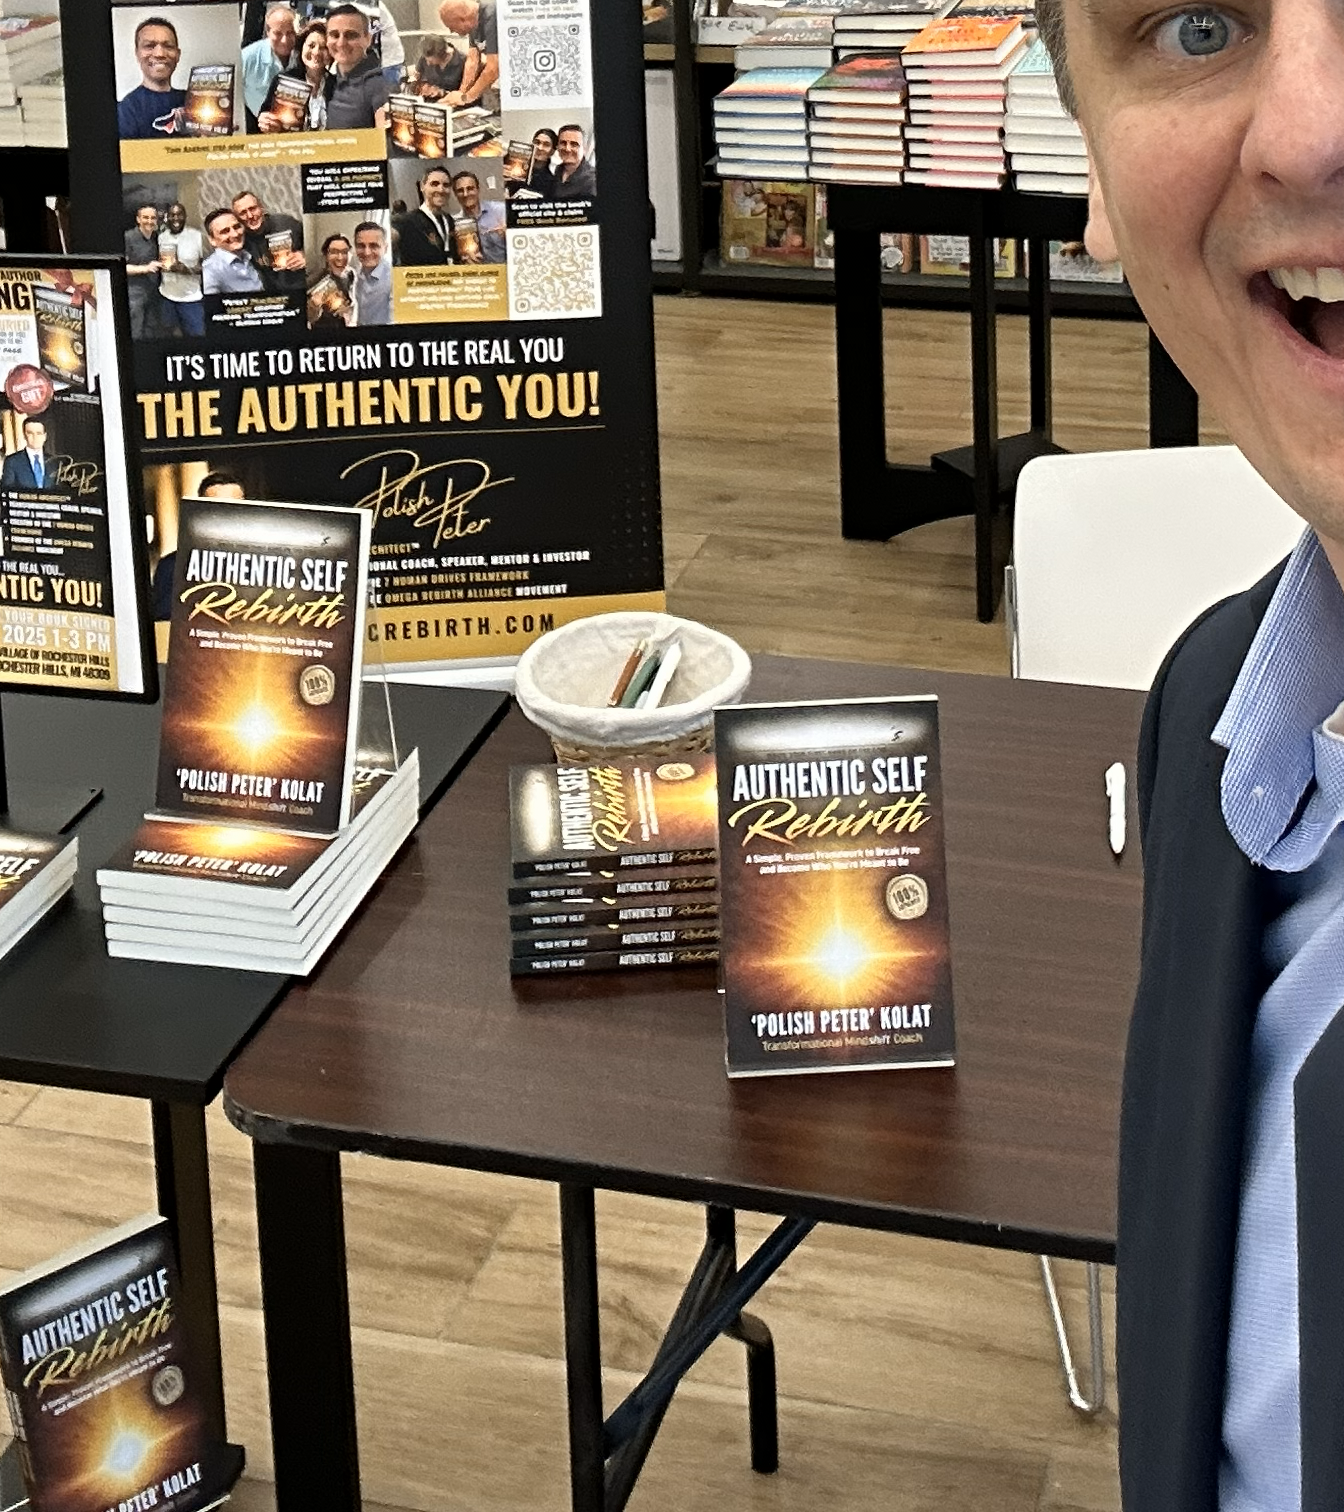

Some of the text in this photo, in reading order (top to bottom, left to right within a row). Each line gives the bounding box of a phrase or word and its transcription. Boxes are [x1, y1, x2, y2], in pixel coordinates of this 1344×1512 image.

[0, 270, 42, 281] AUTHOR
[166, 337, 565, 381] IT'S TIME TO RETURN TO THE REAL YOU
[137, 371, 600, 439] THE AUTHENTIC YOU!
[50, 578, 103, 608] YOU!
[186, 549, 349, 593] AUTHENTIC SELF
[180, 582, 346, 629] Rebirth
[368, 613, 555, 642] CREBIRTH.COM
[2, 624, 46, 646] 2025
[52, 629, 81, 649] 1-3
[86, 632, 112, 653] PM
[280, 779, 325, 803] KOLAT
[732, 755, 928, 802] AUTHENTIC SELF
[557, 767, 596, 850] AUTHENTIC SELF
[588, 765, 636, 852] Rebirth
[728, 792, 932, 848] Rebirth
[880, 1004, 932, 1029] KOLAT
[762, 1033, 924, 1051] Transformational Mindshift Coach
[21, 1267, 169, 1366] AUTHENTIC SELF
[22, 1297, 173, 1398] Rebirth
